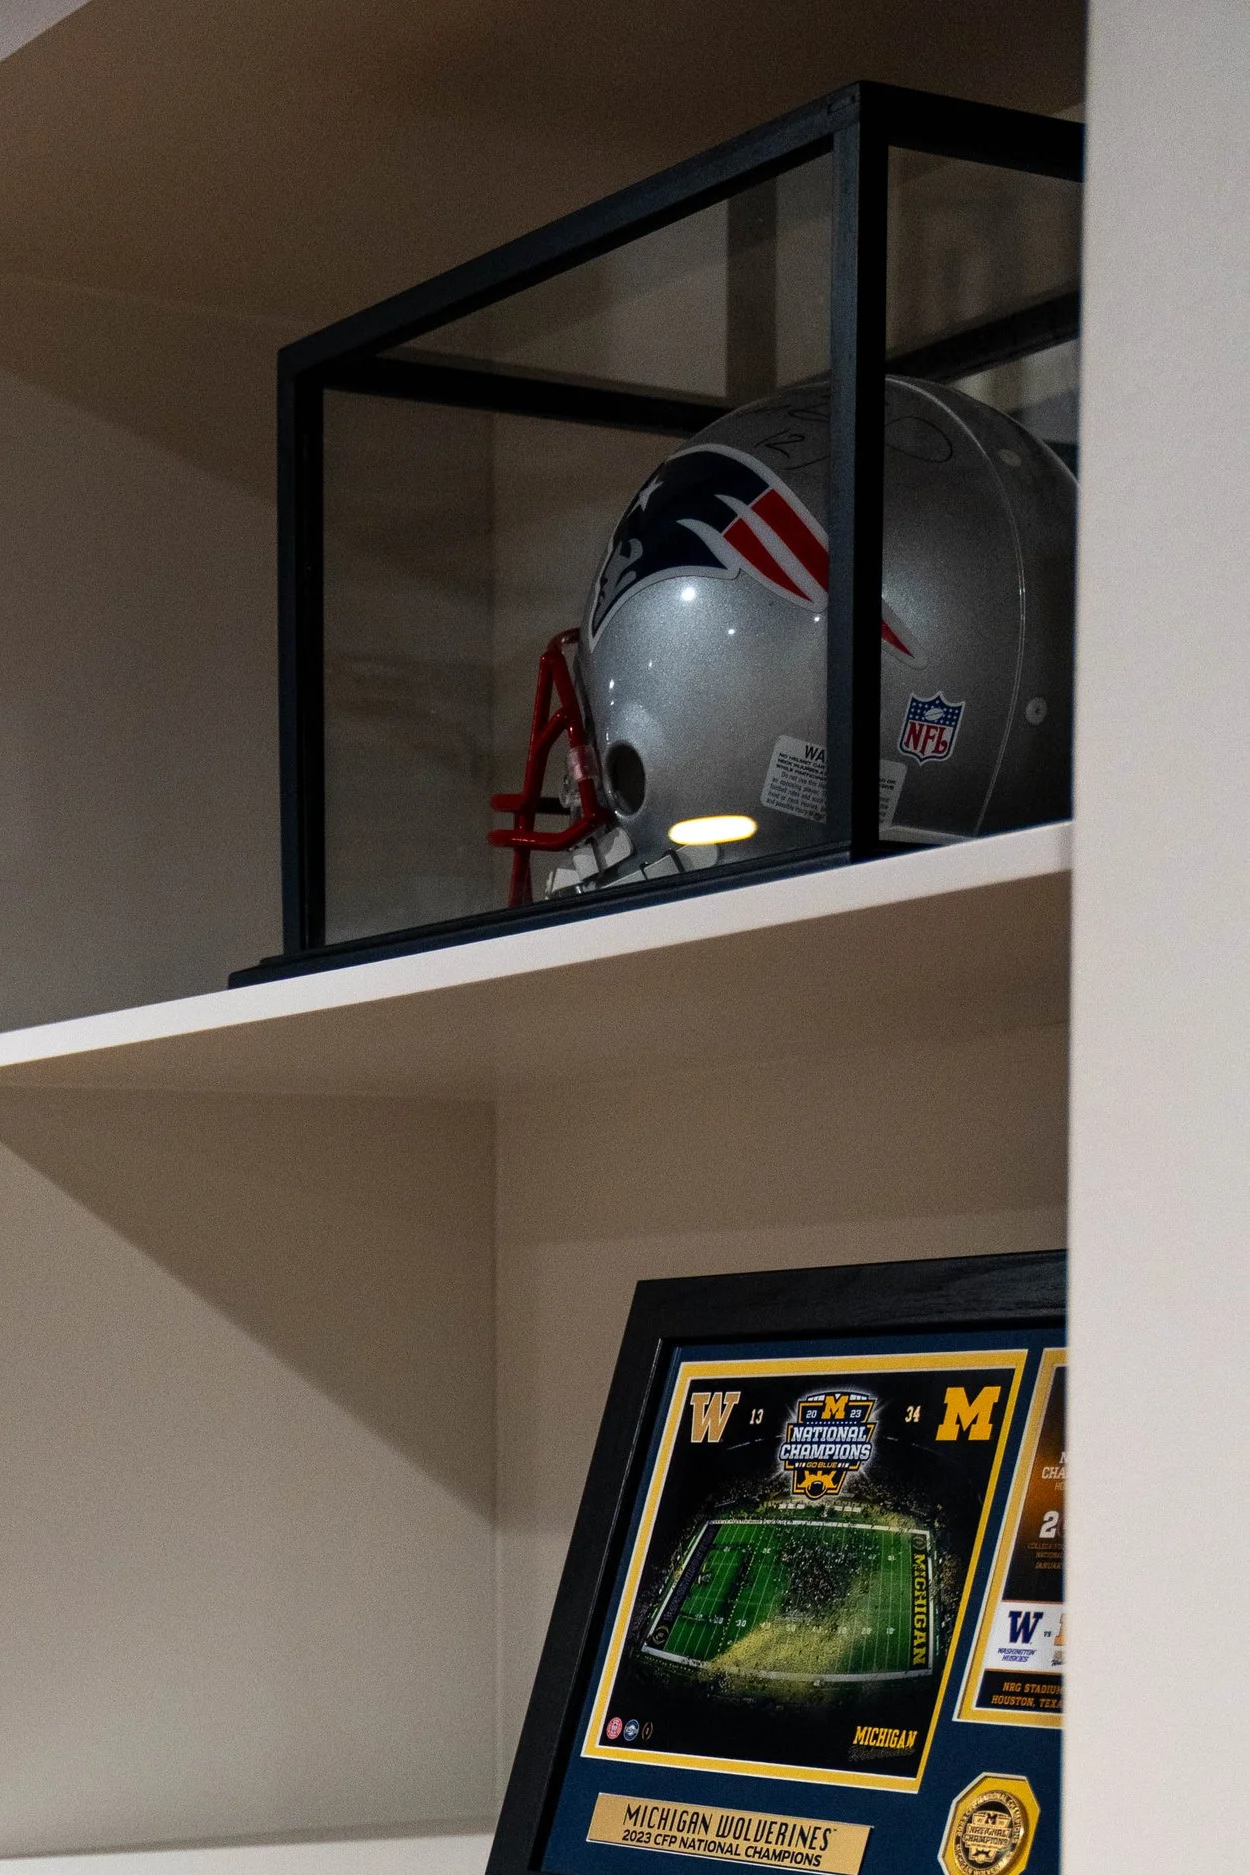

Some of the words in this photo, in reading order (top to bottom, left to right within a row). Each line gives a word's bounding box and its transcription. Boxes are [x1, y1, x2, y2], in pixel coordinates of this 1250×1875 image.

[904, 721, 948, 756] NFL
[690, 1391, 741, 1443] W
[749, 1409, 764, 1424] 13
[806, 1410, 817, 1418] 20
[821, 1395, 849, 1419] M
[850, 1409, 862, 1418] 23
[905, 1405, 921, 1422] 34
[935, 1386, 1002, 1441] M
[790, 1426, 867, 1442] NATIONAL
[779, 1443, 871, 1460] CHAMPIONS
[913, 1553, 927, 1666] MICHIGAN
[1008, 1610, 1044, 1644] W
[998, 1648, 1037, 1656] WASHINGTON
[1002, 1682, 1021, 1692] NRG
[991, 1695, 1036, 1707] HOUSTON,
[852, 1726, 918, 1749] MICHIGAN
[623, 1803, 713, 1835] MICHIGAN
[622, 1829, 652, 1844] 2023
[653, 1833, 677, 1847] CFP
[679, 1837, 742, 1857] NATIONAL
[744, 1845, 822, 1867] CHAMPIONS
